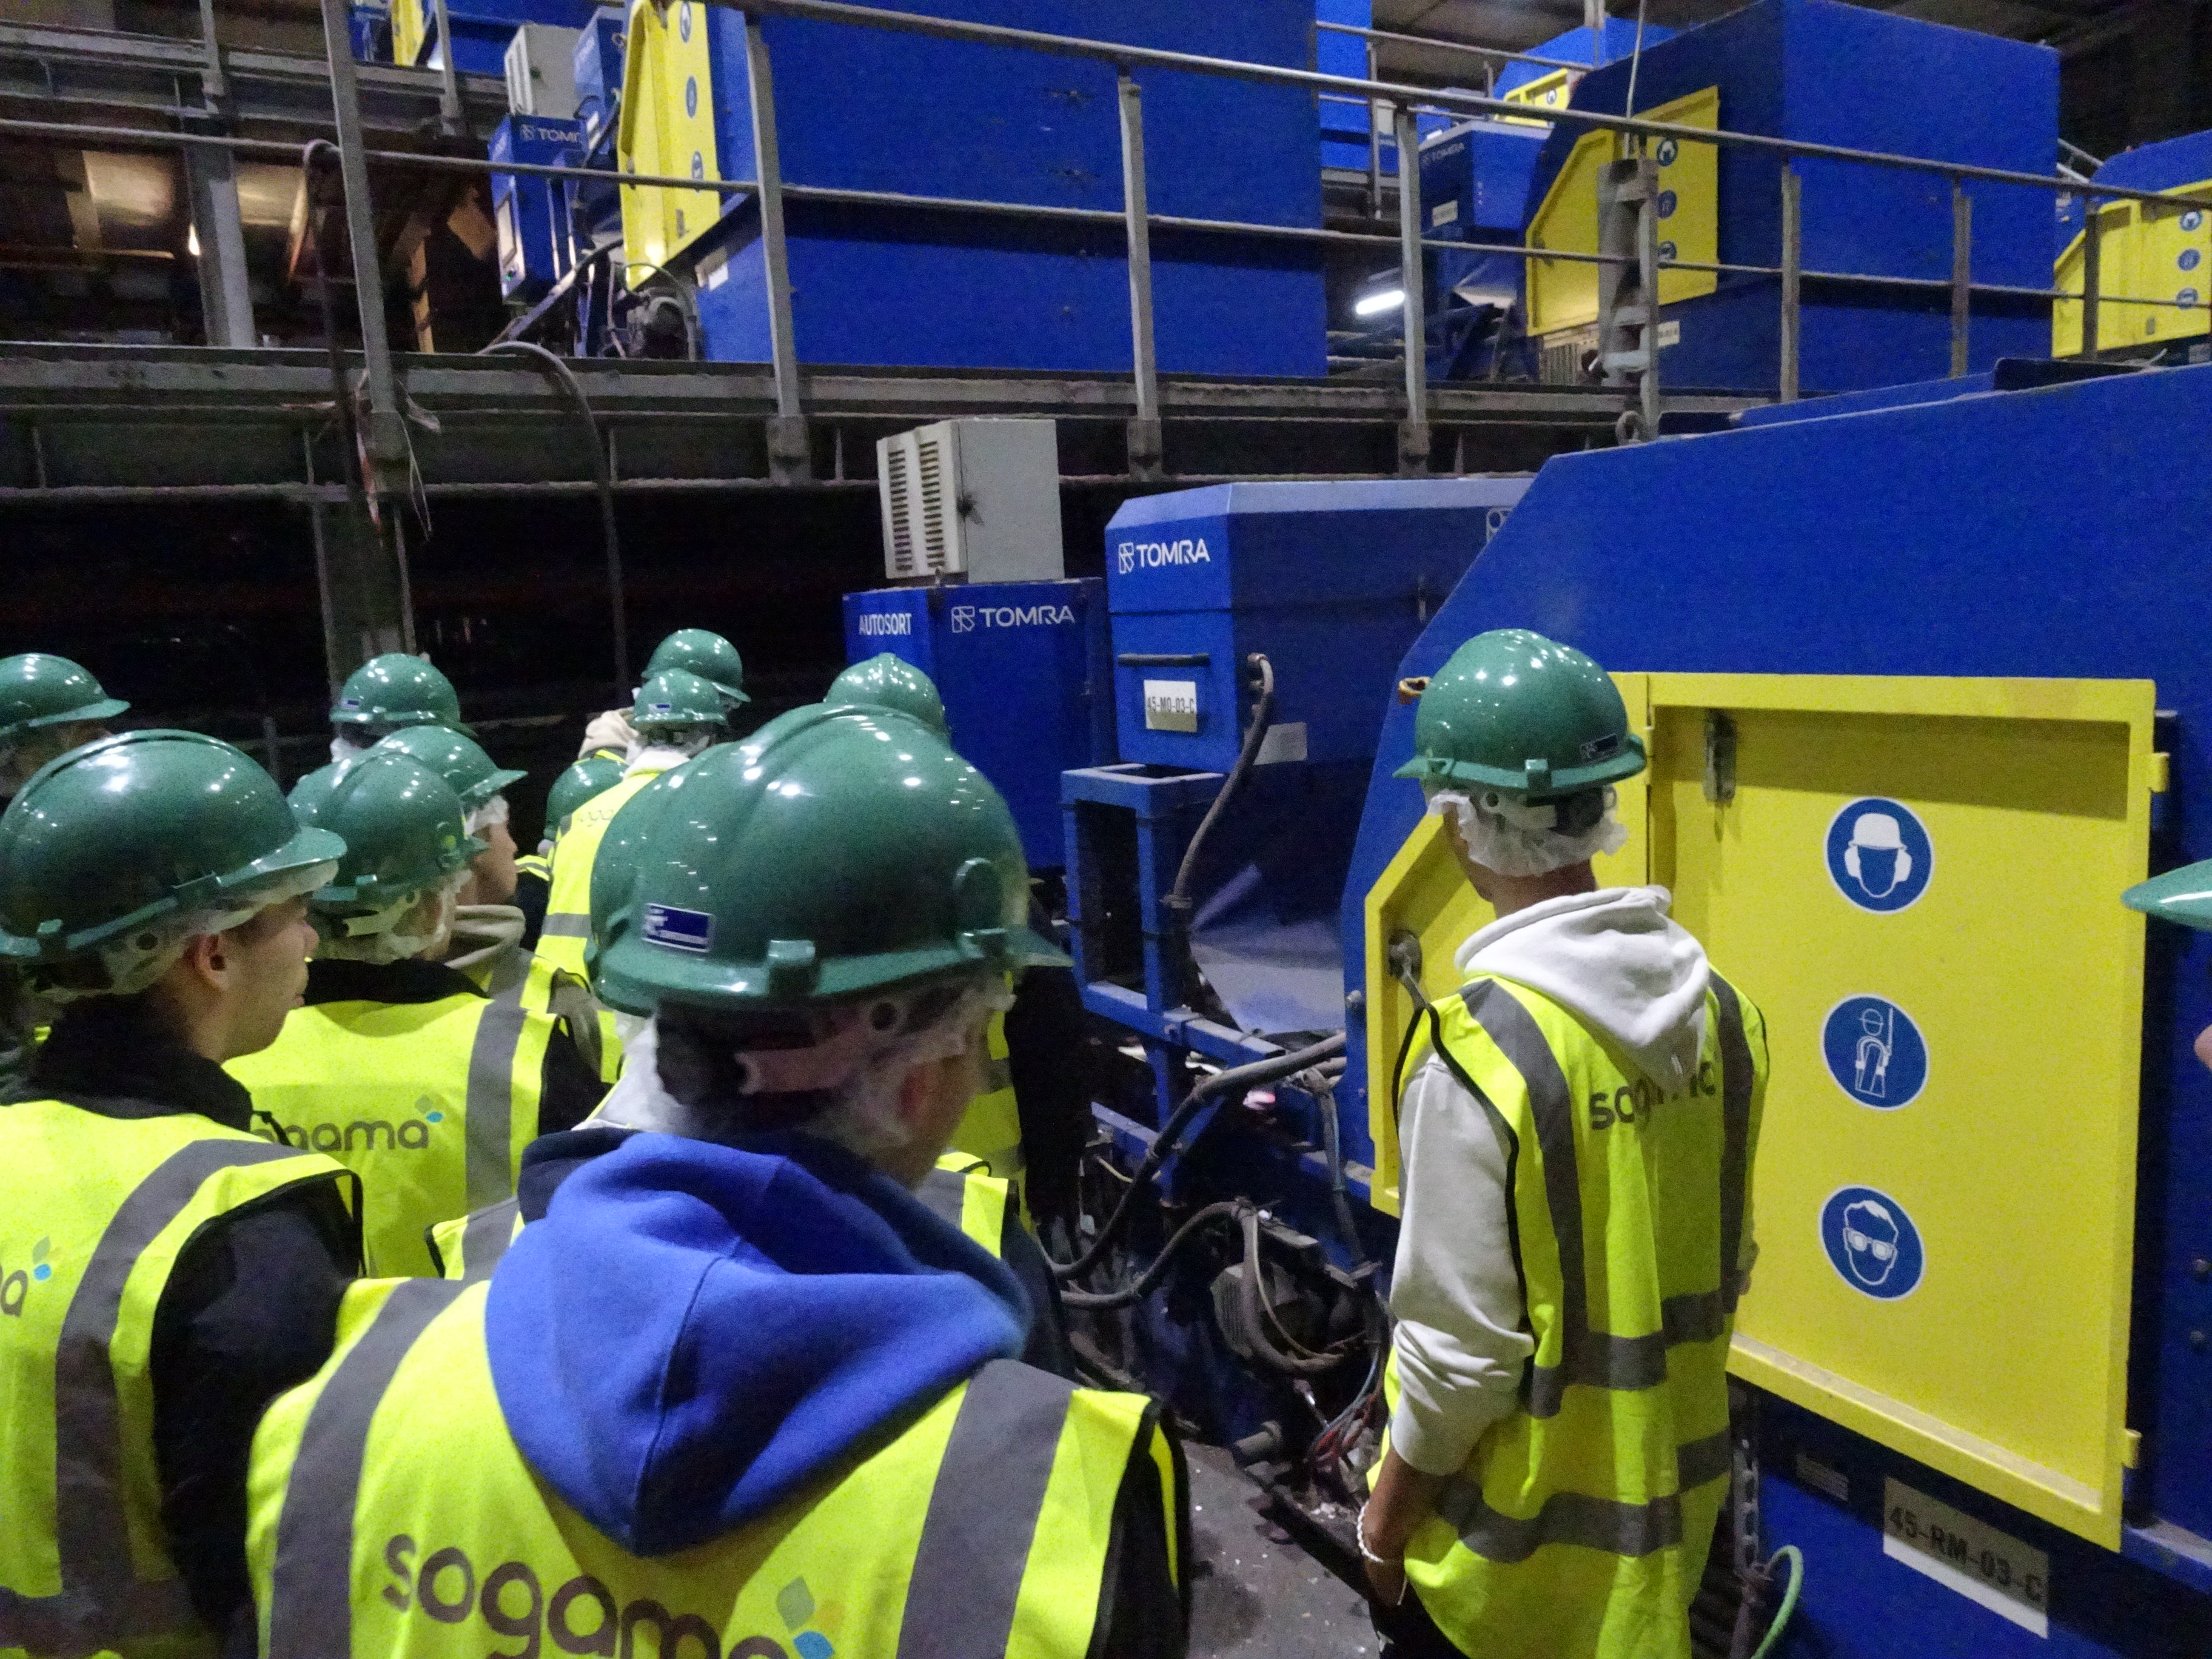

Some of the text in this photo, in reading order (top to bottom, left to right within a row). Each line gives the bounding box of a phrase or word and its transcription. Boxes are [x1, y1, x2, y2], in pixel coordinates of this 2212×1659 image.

[1136, 538, 1211, 568] TOMRA
[859, 613, 912, 635] AUTOSORT
[979, 606, 1076, 628] TOMRA
